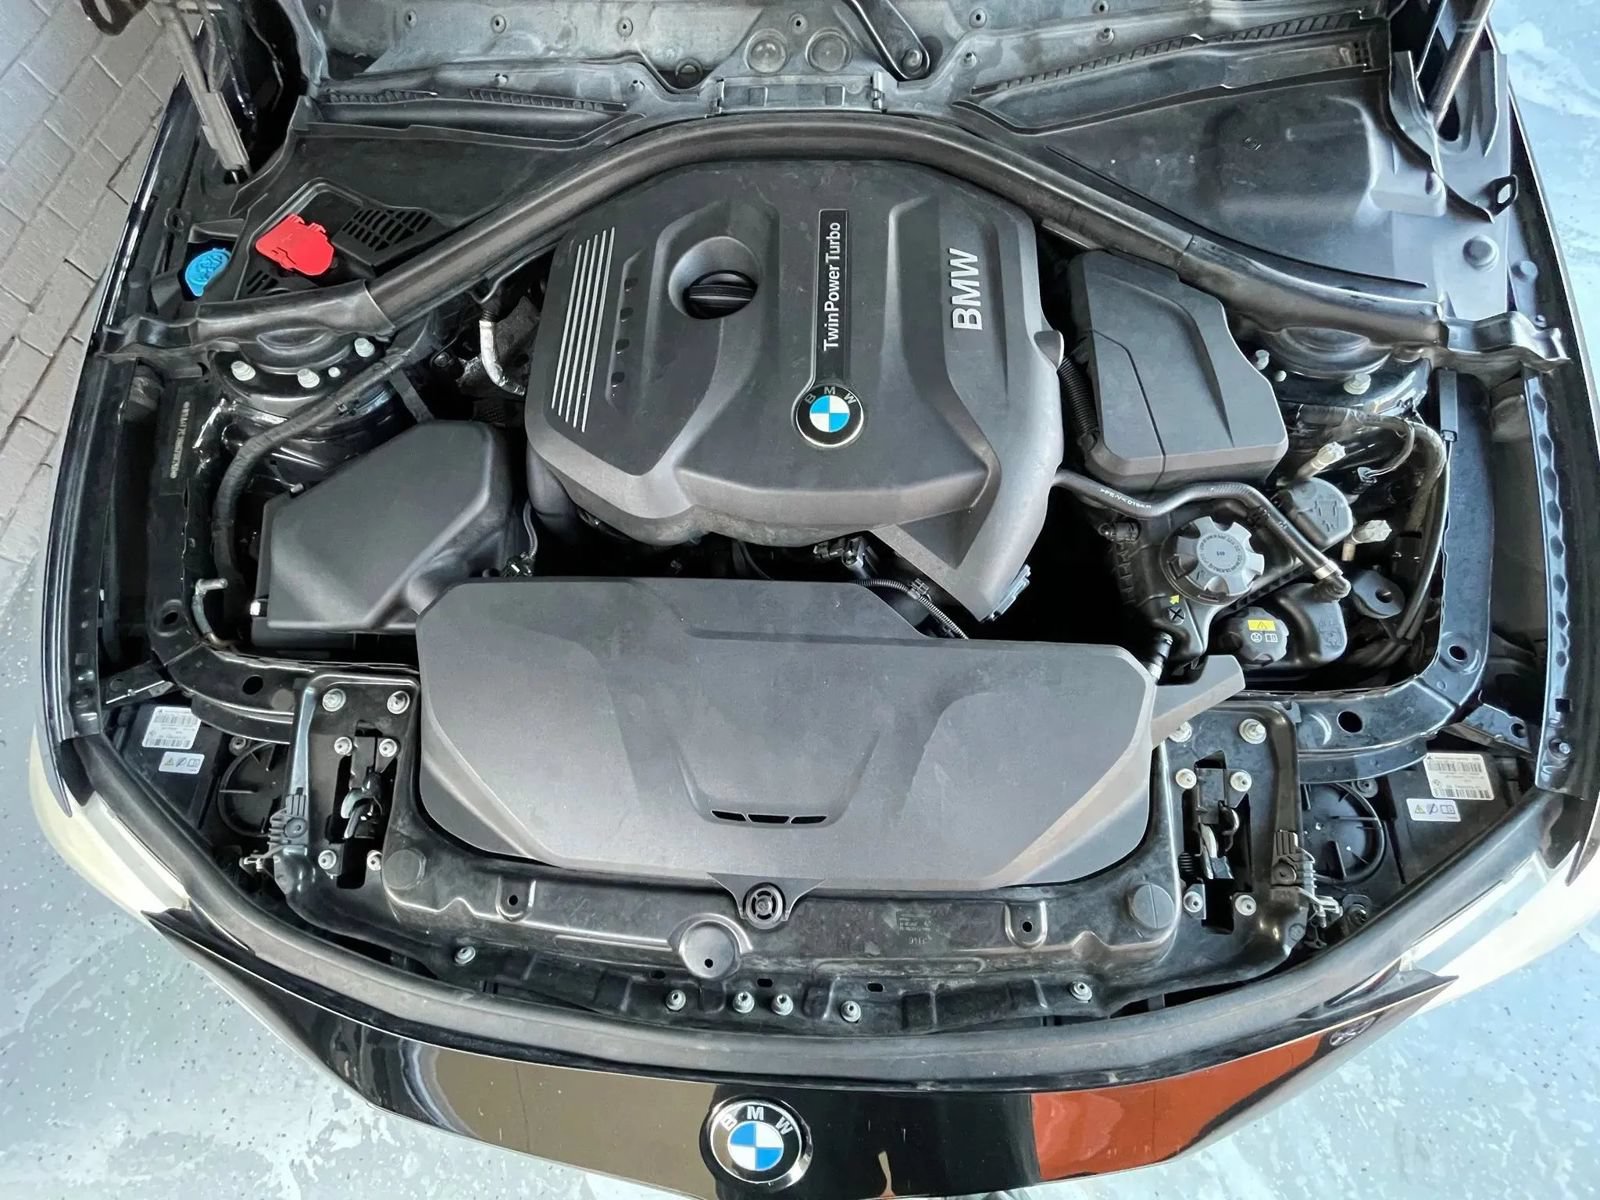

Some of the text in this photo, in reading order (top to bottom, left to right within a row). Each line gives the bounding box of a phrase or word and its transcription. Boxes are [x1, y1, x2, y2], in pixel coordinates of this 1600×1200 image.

[823, 222, 841, 352] TwinPower Turbo
[949, 247, 983, 331] BMW
[804, 385, 857, 405] BMW
[720, 1105, 794, 1136] BMW
